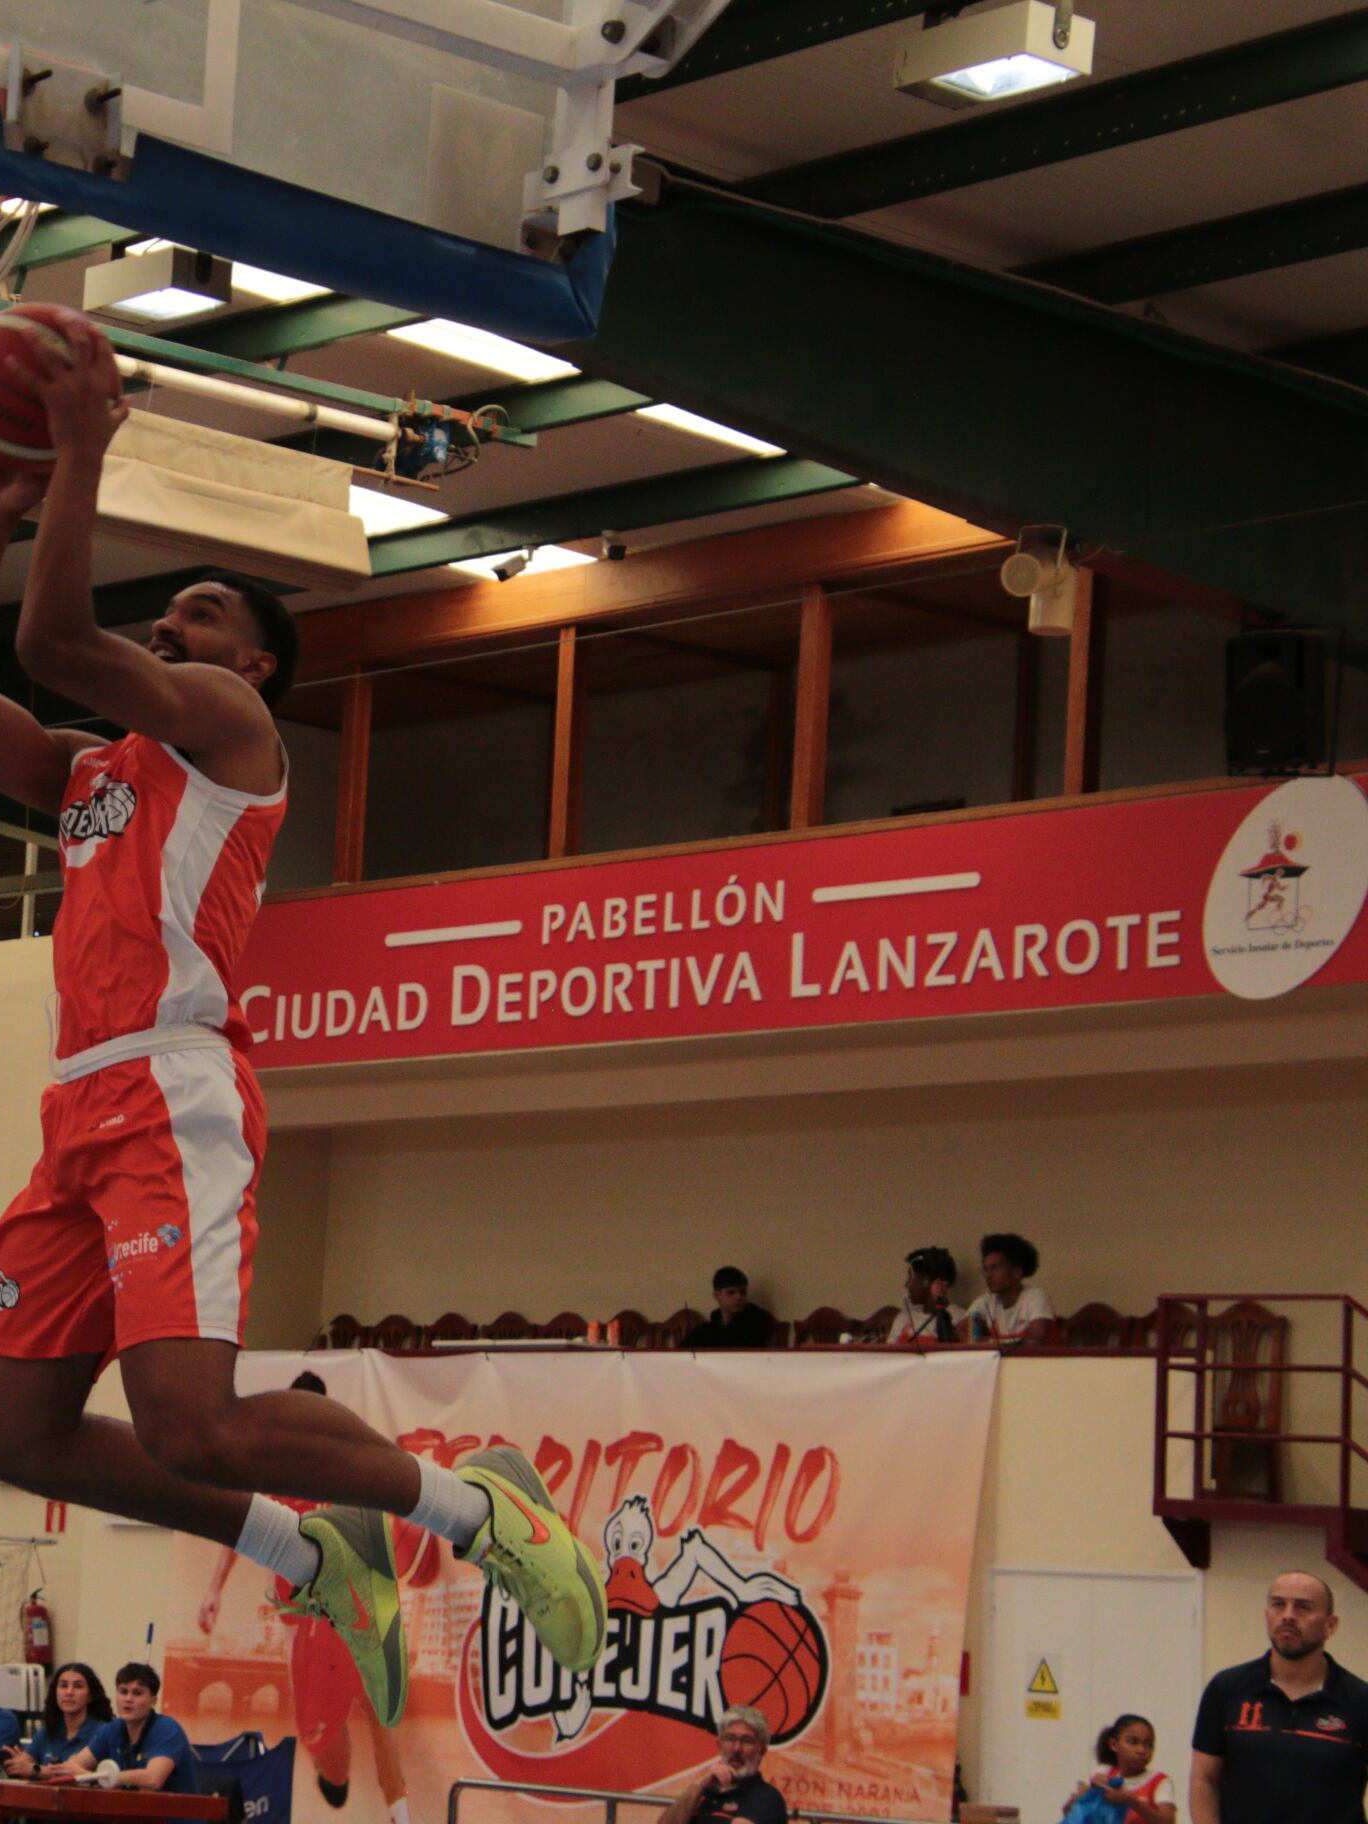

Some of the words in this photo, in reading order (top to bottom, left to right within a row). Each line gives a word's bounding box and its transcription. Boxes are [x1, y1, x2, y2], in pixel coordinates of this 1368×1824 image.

[542, 875, 786, 945] PABELLÓN
[238, 982, 429, 1044] CIUDAD
[450, 951, 762, 1026] DEPORTIVA
[790, 909, 1182, 998] LANZAROTE
